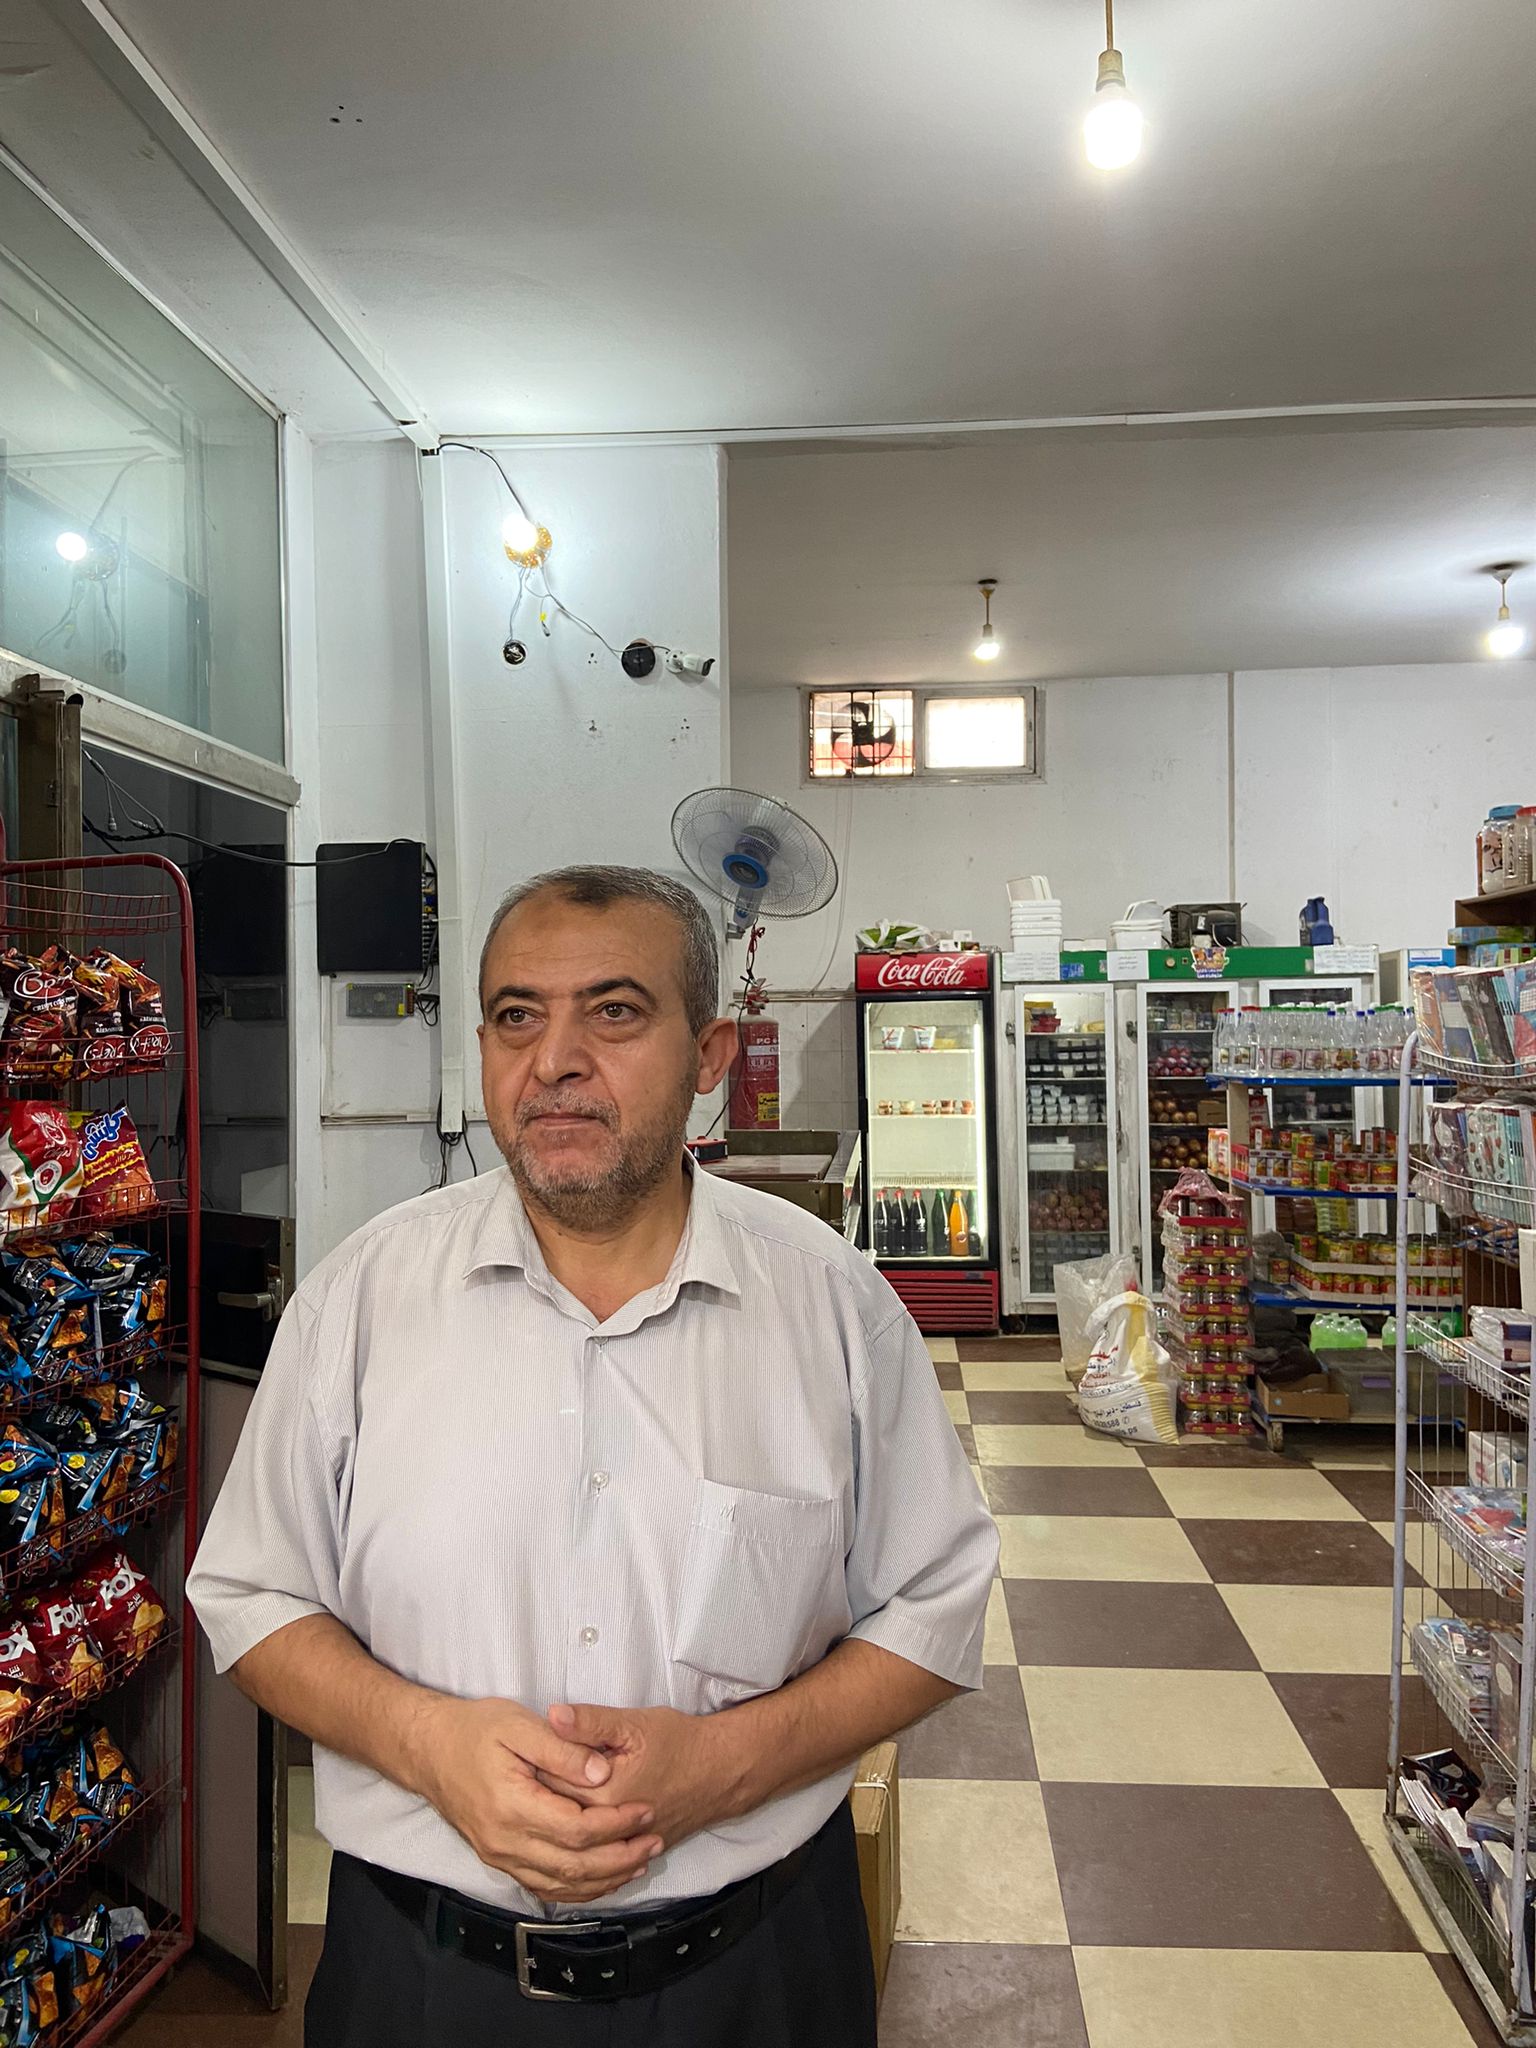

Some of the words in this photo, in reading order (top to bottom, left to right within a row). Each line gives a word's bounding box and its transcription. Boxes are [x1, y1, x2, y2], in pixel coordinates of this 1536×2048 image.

[877, 956, 971, 987] Coca-Cola
[100, 1555, 146, 1611] FOX
[0, 1624, 37, 1662] OX
